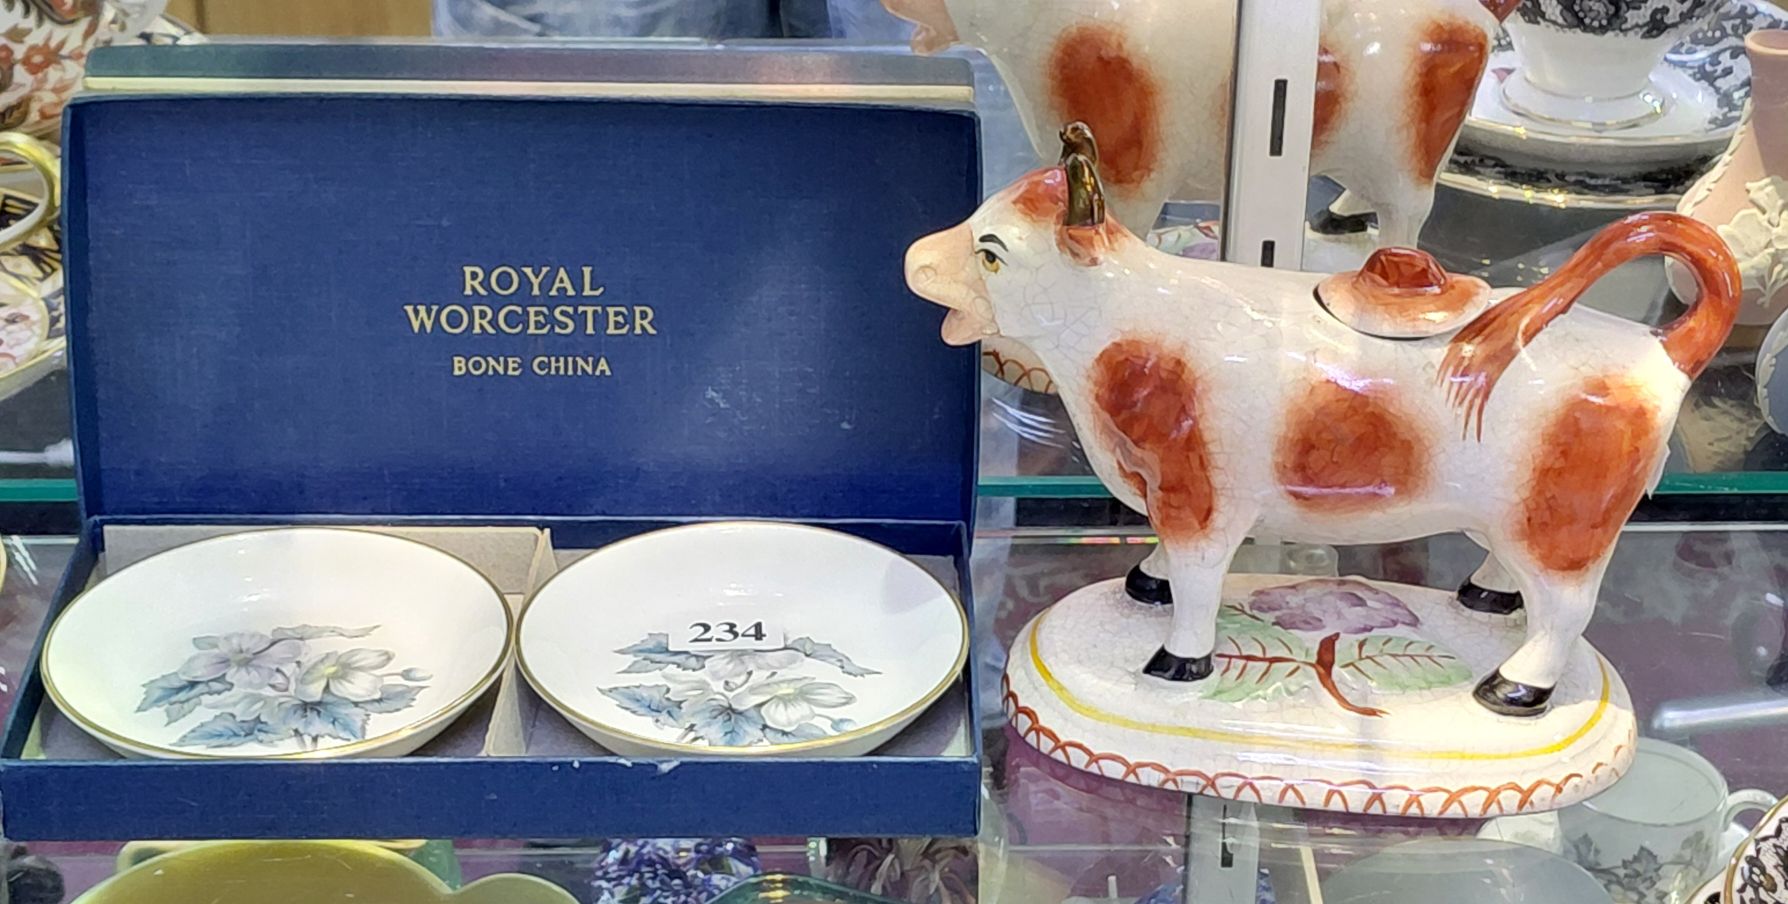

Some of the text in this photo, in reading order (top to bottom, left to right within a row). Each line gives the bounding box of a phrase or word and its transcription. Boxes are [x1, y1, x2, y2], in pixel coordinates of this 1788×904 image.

[463, 266, 604, 296] ROYAL
[403, 304, 657, 335] WORCESTER
[453, 356, 612, 376] BONE CHINA
[688, 621, 767, 643] 234
